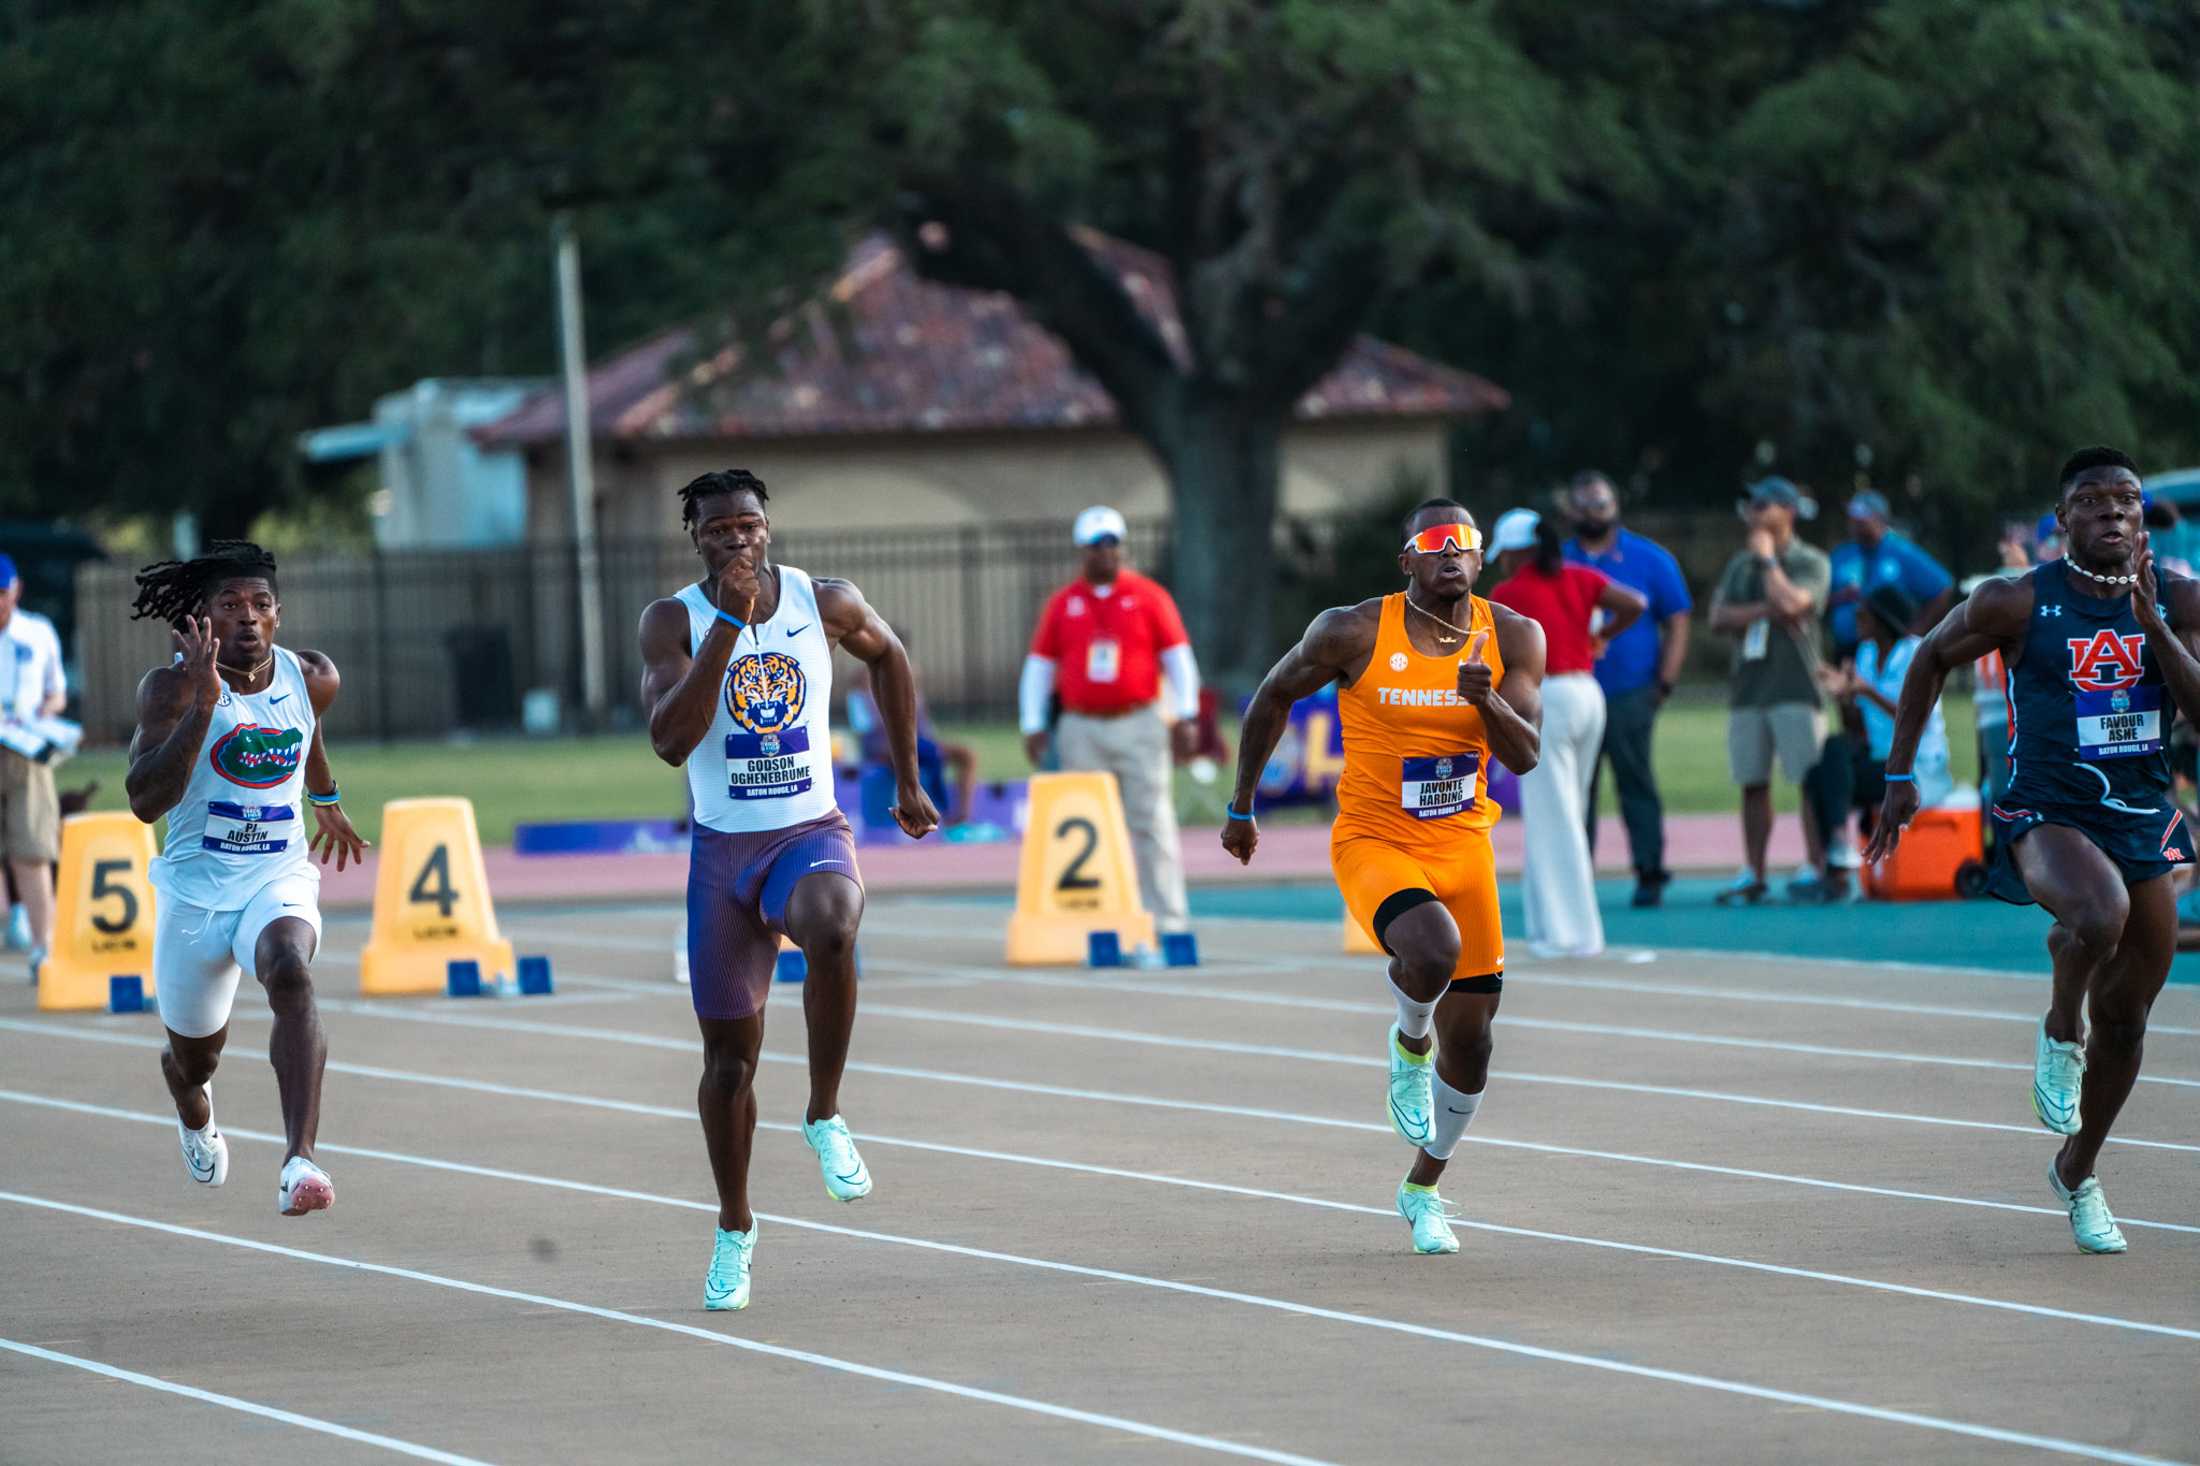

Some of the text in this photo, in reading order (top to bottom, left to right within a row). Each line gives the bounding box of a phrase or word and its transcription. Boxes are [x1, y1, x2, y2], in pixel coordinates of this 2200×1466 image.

[2100, 714, 2144, 730] FAVOUR
[2108, 727, 2138, 742] ASHE
[2142, 743, 2149, 752] LA
[747, 756, 794, 772] GODSON
[731, 766, 810, 785] OGHENEBRUME
[746, 788, 768, 797] BATON
[790, 784, 798, 793] LA
[1420, 790, 1463, 806] HARDING
[245, 822, 258, 833] PJ
[227, 830, 268, 843] AUSTIN
[220, 842, 240, 852] BATON
[262, 843, 271, 851] LA
[1056, 817, 1102, 891] 2
[409, 842, 460, 918] 4
[92, 859, 138, 935] 5
